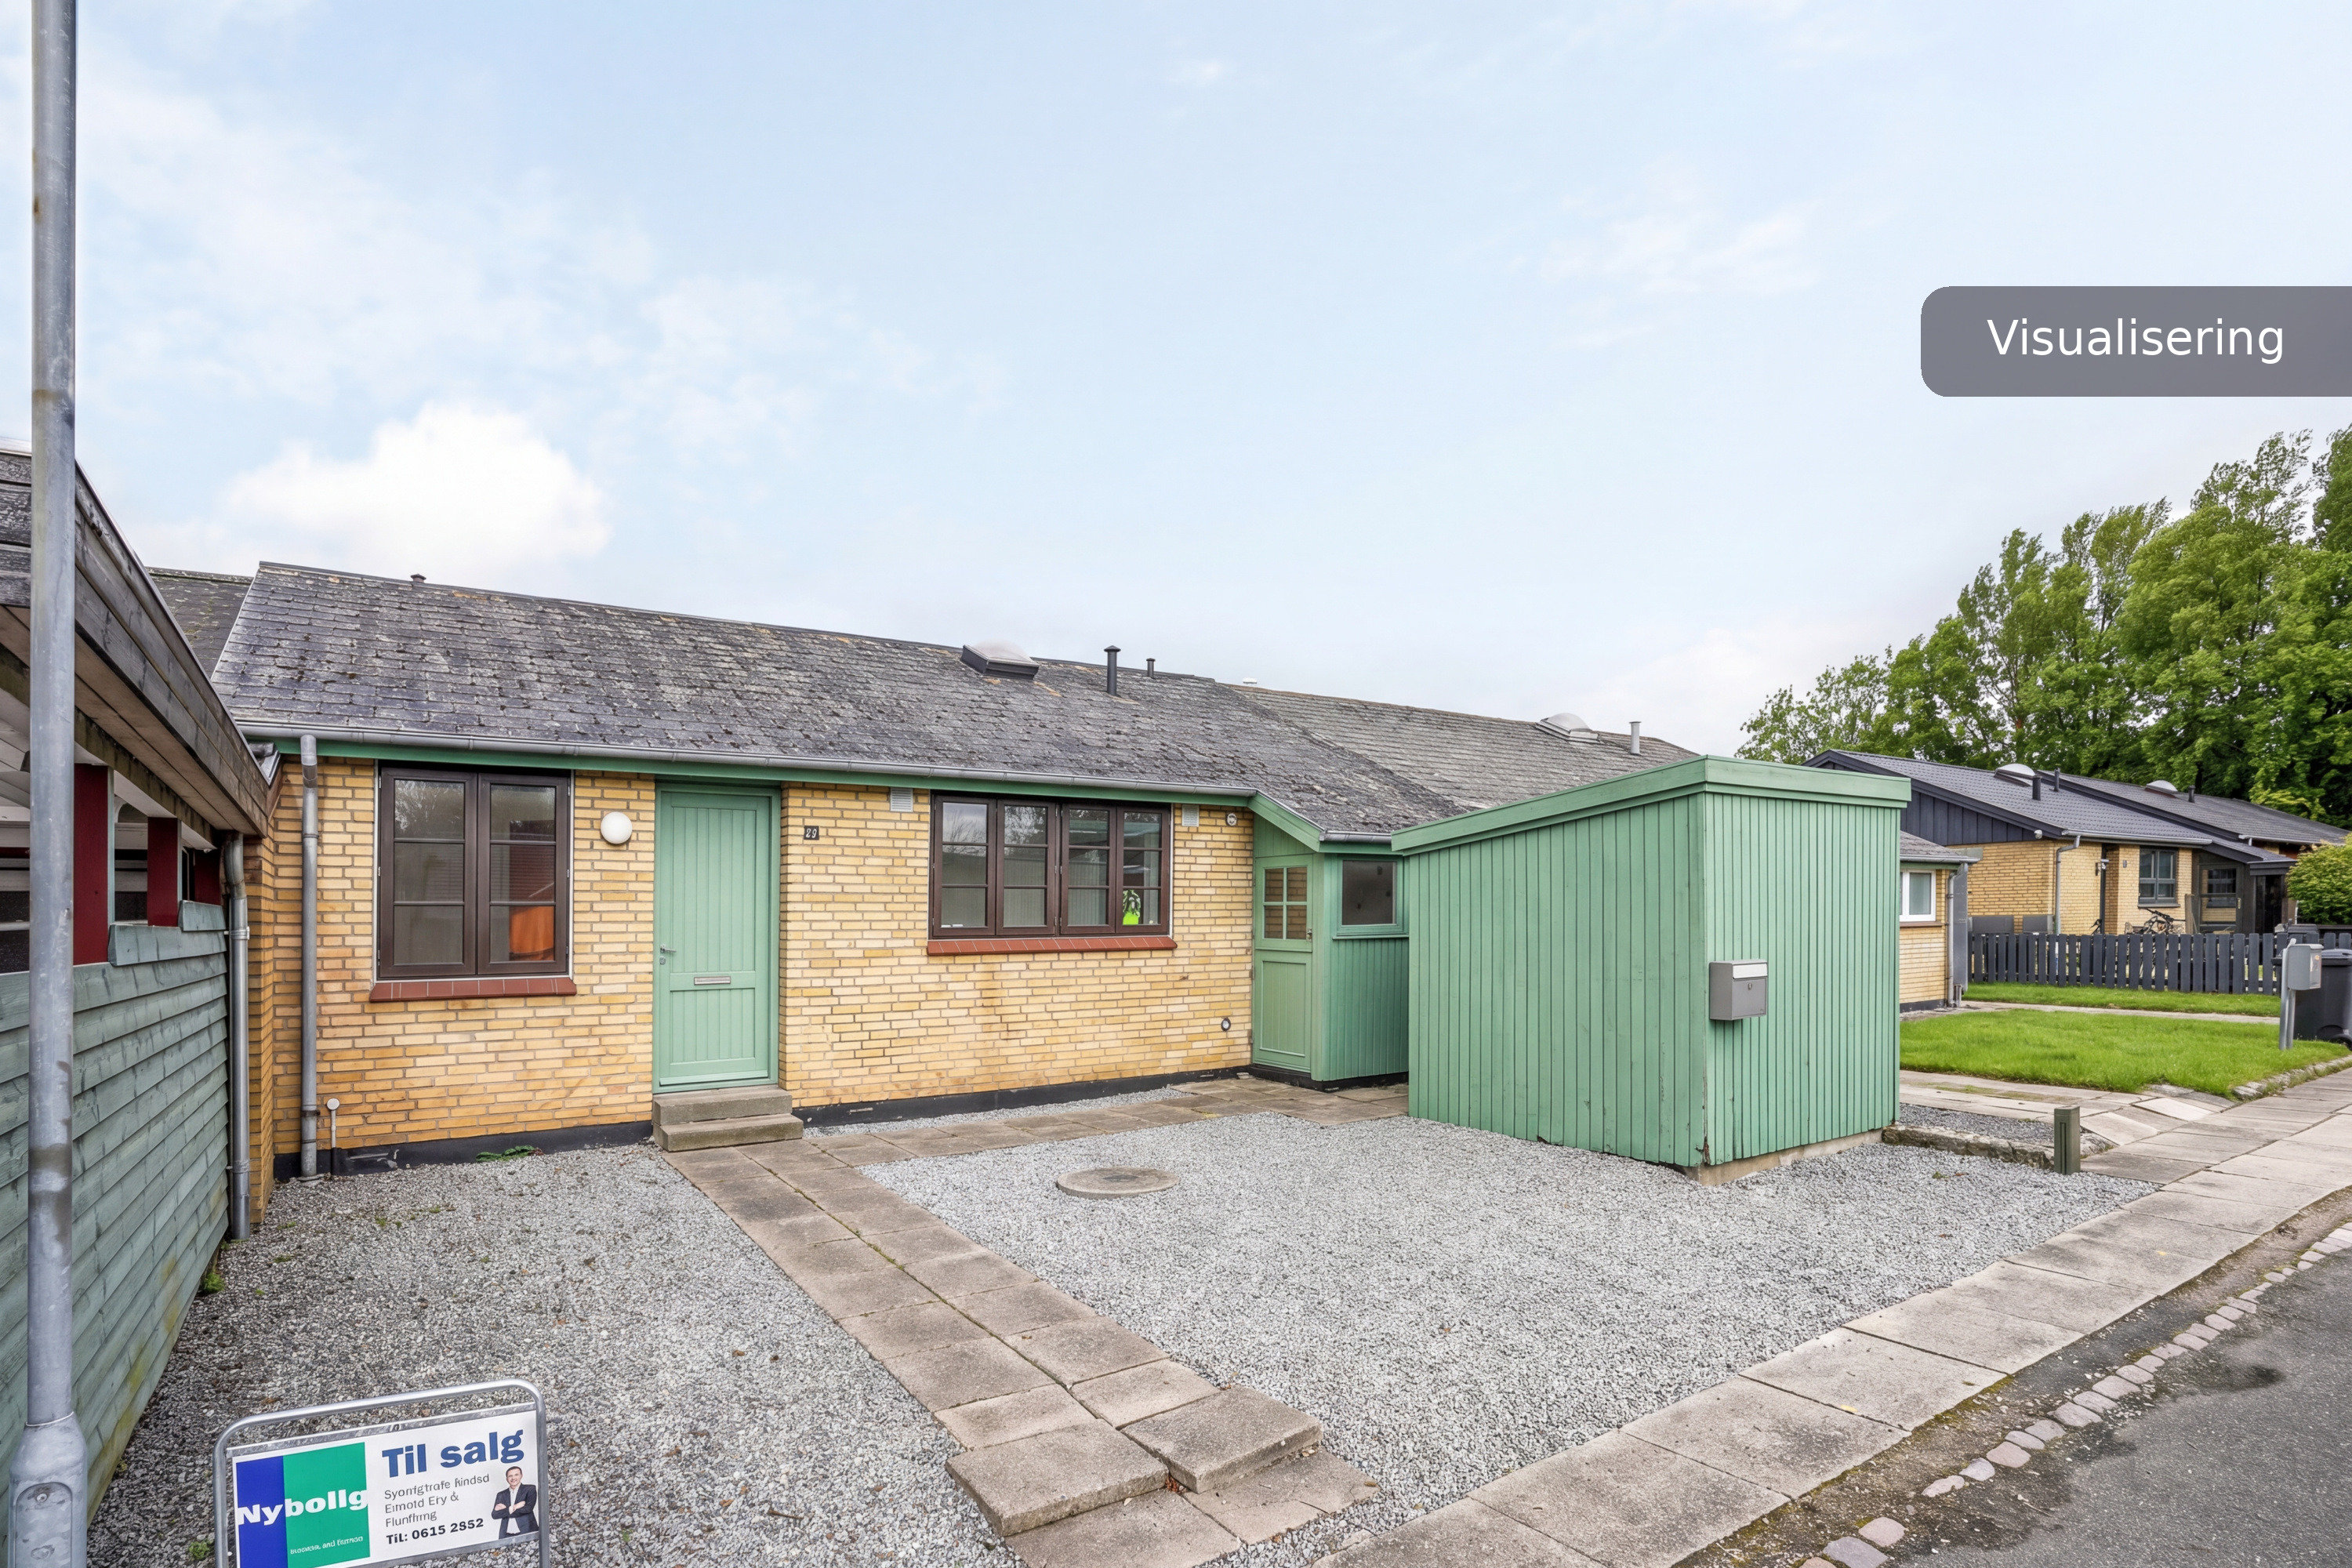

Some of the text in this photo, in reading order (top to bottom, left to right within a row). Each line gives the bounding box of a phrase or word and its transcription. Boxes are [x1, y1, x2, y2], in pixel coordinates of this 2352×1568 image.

[805, 828, 818, 839] 29
[382, 1429, 524, 1478] Til salg
[412, 1525, 446, 1540] 0615
